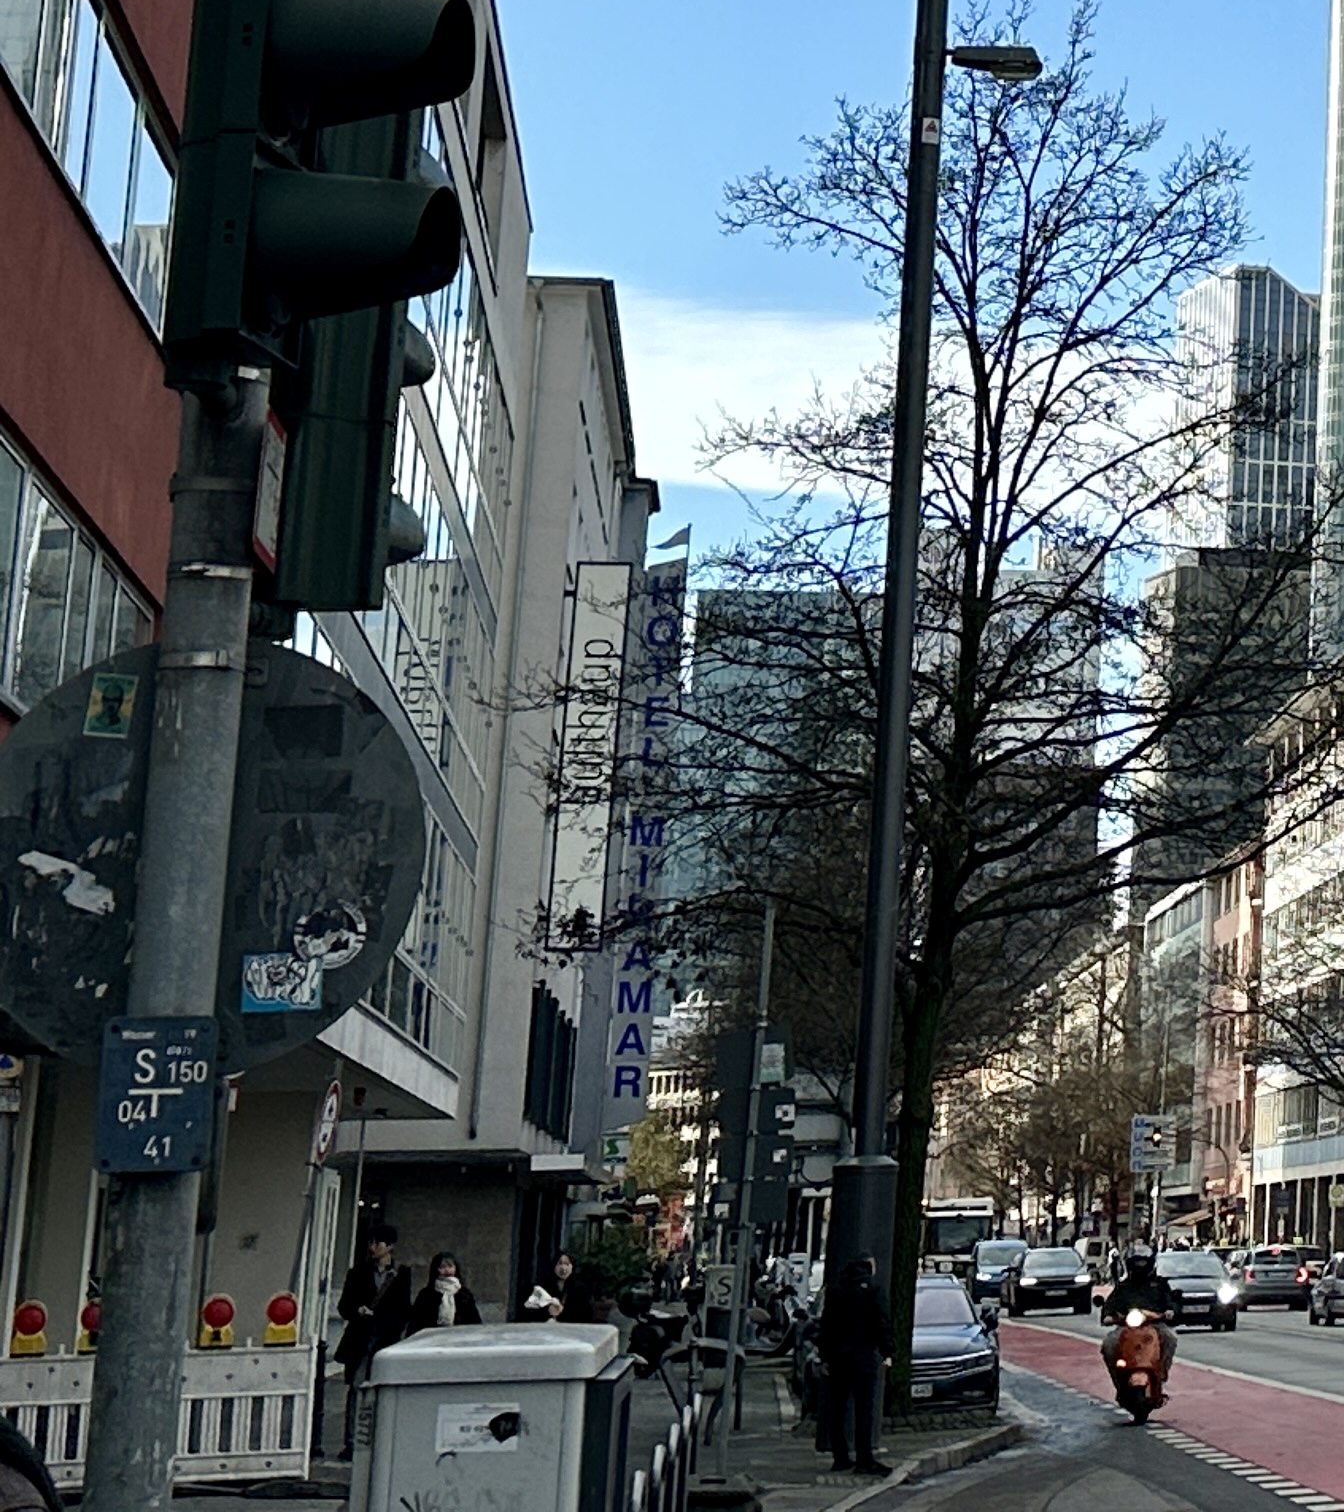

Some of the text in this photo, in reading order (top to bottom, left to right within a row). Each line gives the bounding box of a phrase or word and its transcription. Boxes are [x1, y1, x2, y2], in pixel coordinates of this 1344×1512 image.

[558, 639, 623, 805] bulthaup
[642, 574, 684, 765] HOTEL
[133, 1048, 208, 1084] S 150
